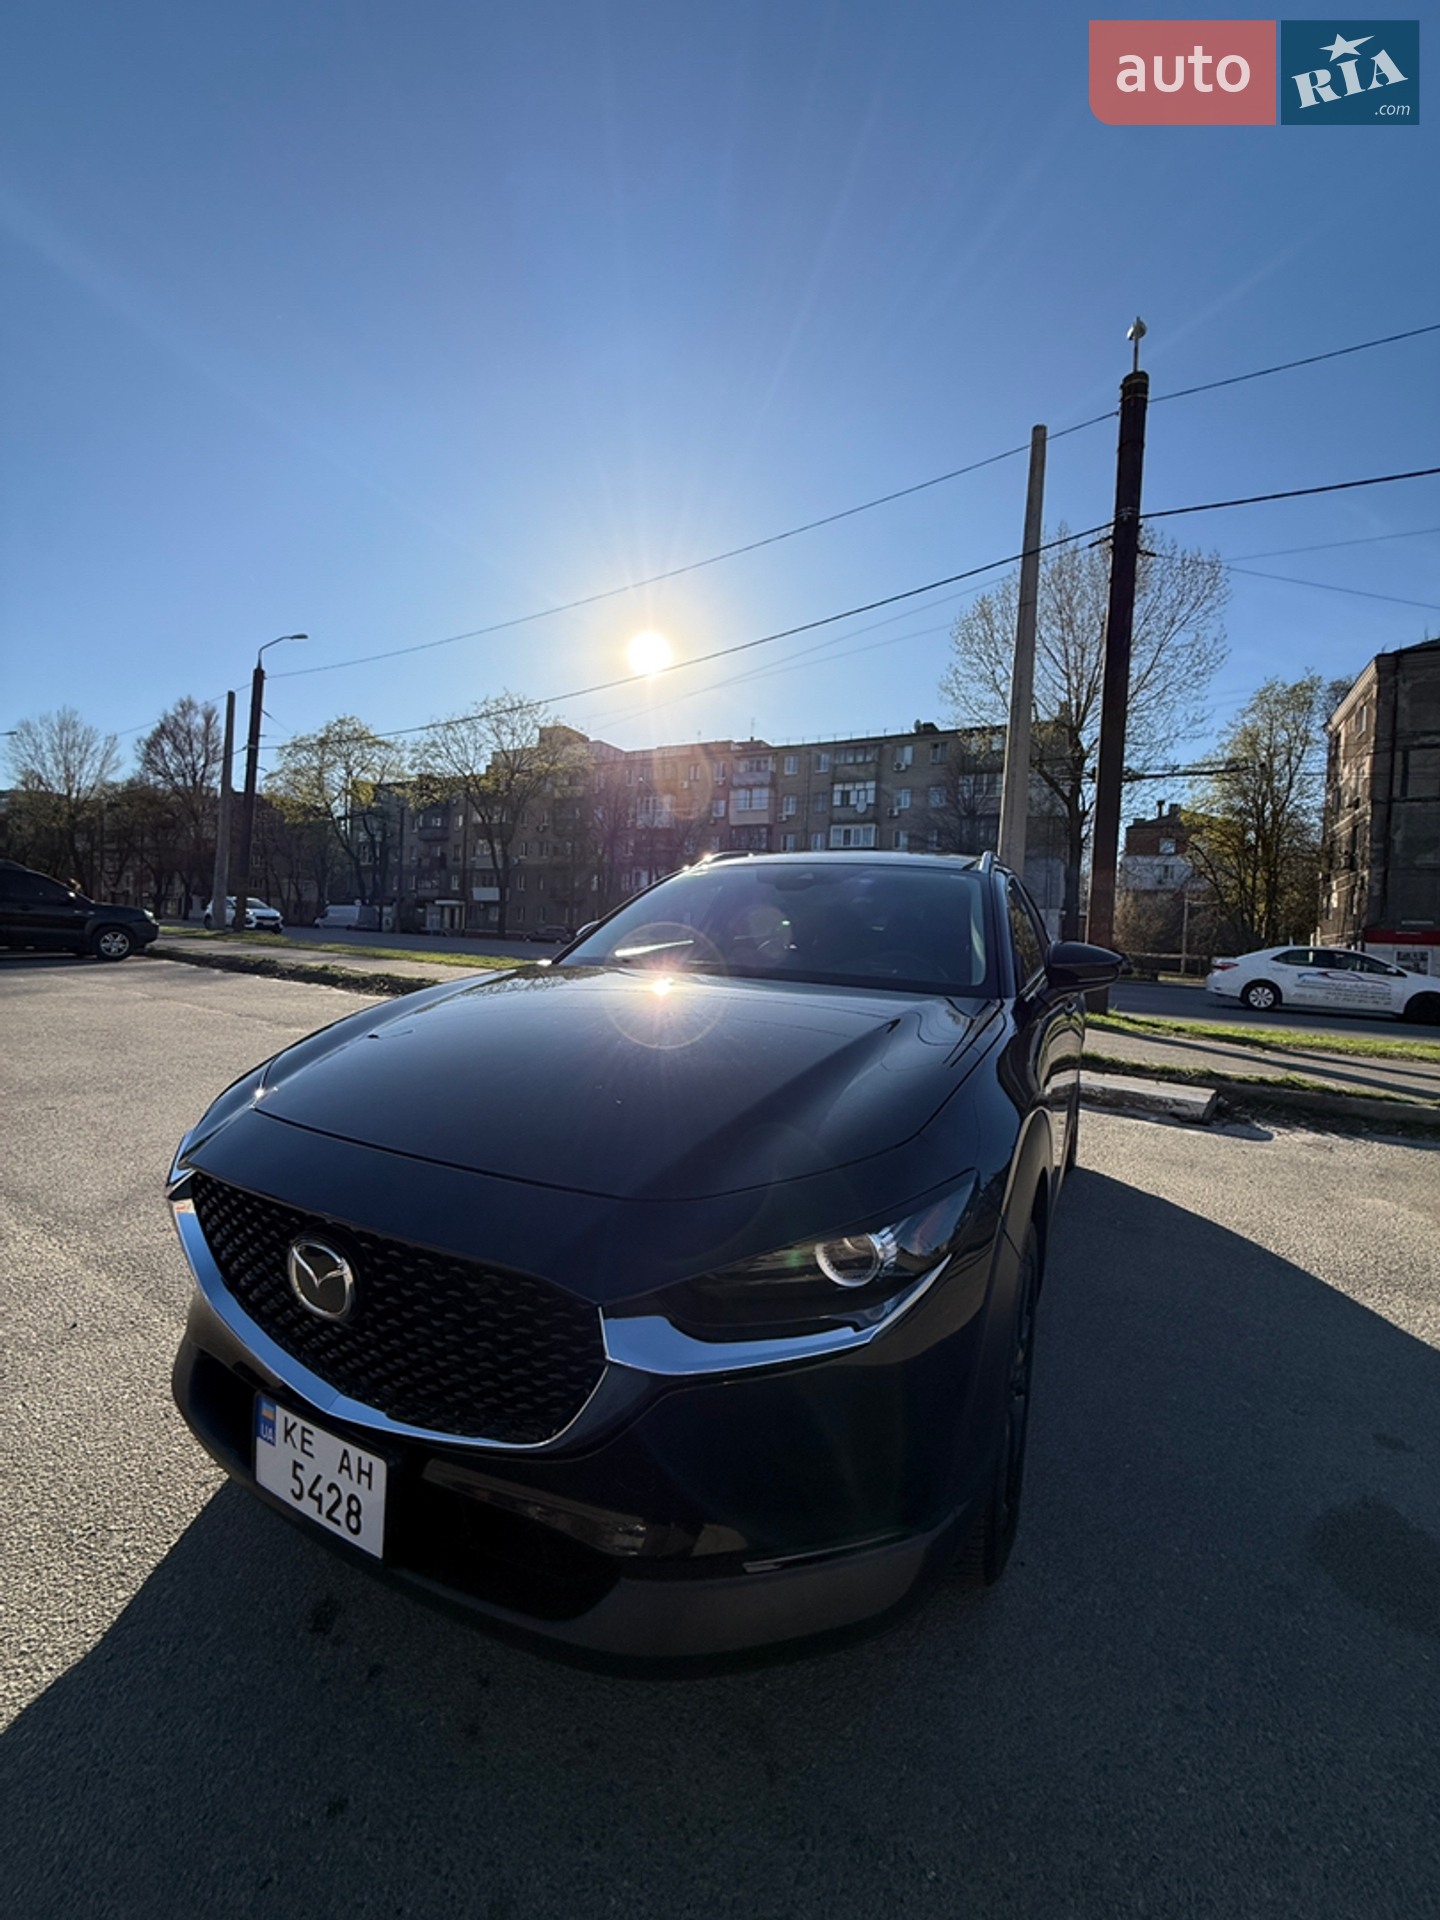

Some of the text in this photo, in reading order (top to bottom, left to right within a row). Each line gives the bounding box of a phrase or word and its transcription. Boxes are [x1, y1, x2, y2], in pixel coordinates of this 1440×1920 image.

[261, 1423, 274, 1442] UA
[284, 1416, 373, 1491] KE AH
[290, 1459, 362, 1536] 5428
